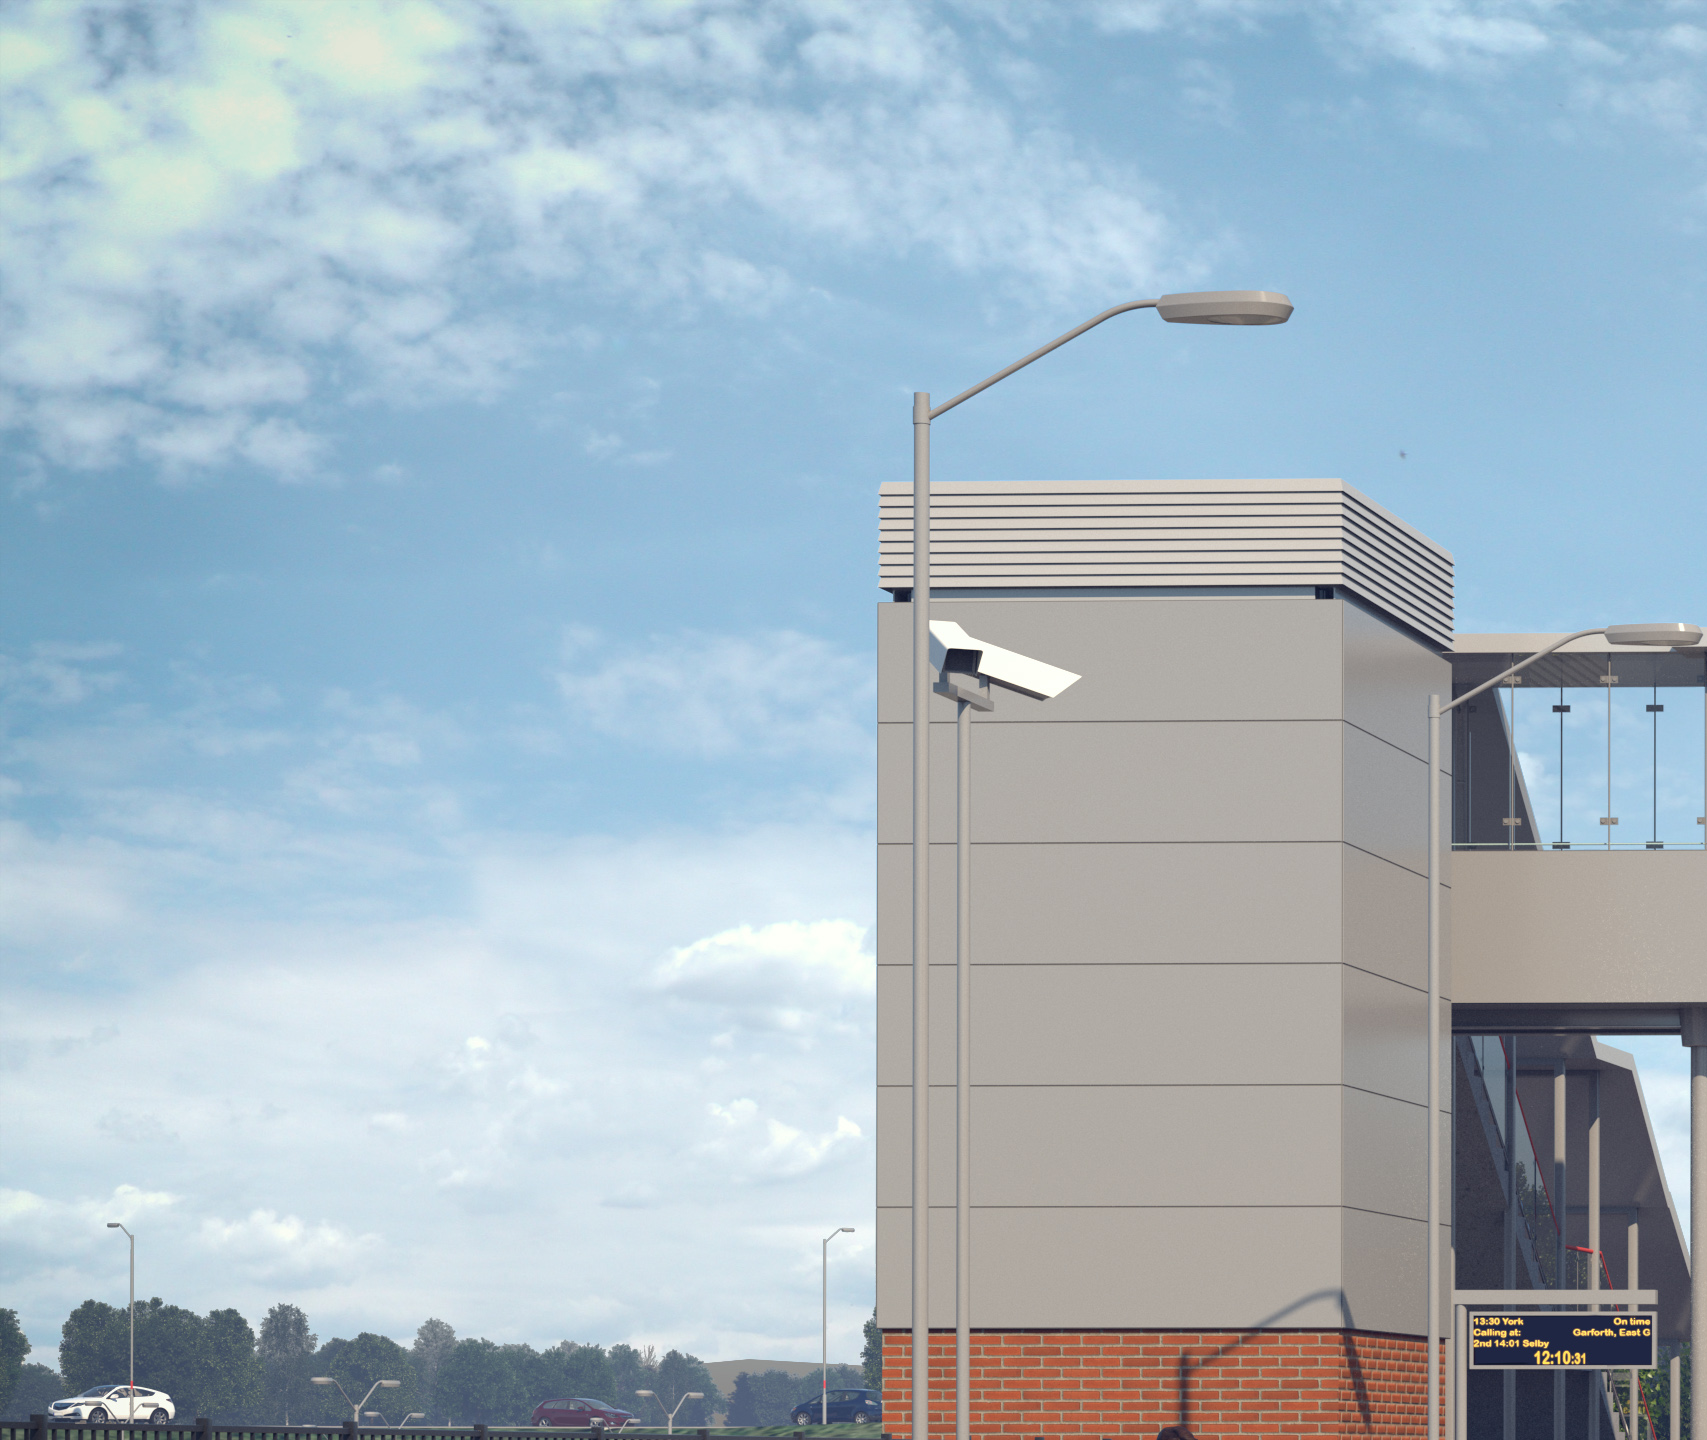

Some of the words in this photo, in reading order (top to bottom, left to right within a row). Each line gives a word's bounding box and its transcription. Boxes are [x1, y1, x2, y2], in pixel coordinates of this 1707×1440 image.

[1473, 1329, 1507, 1337] Calling
[1573, 1329, 1617, 1337] Garforth,
[1473, 1340, 1492, 1348] 2nd
[1494, 1340, 1520, 1348] 14:01
[1523, 1340, 1549, 1349] Selby
[1534, 1351, 1586, 1365] 12:10:31
